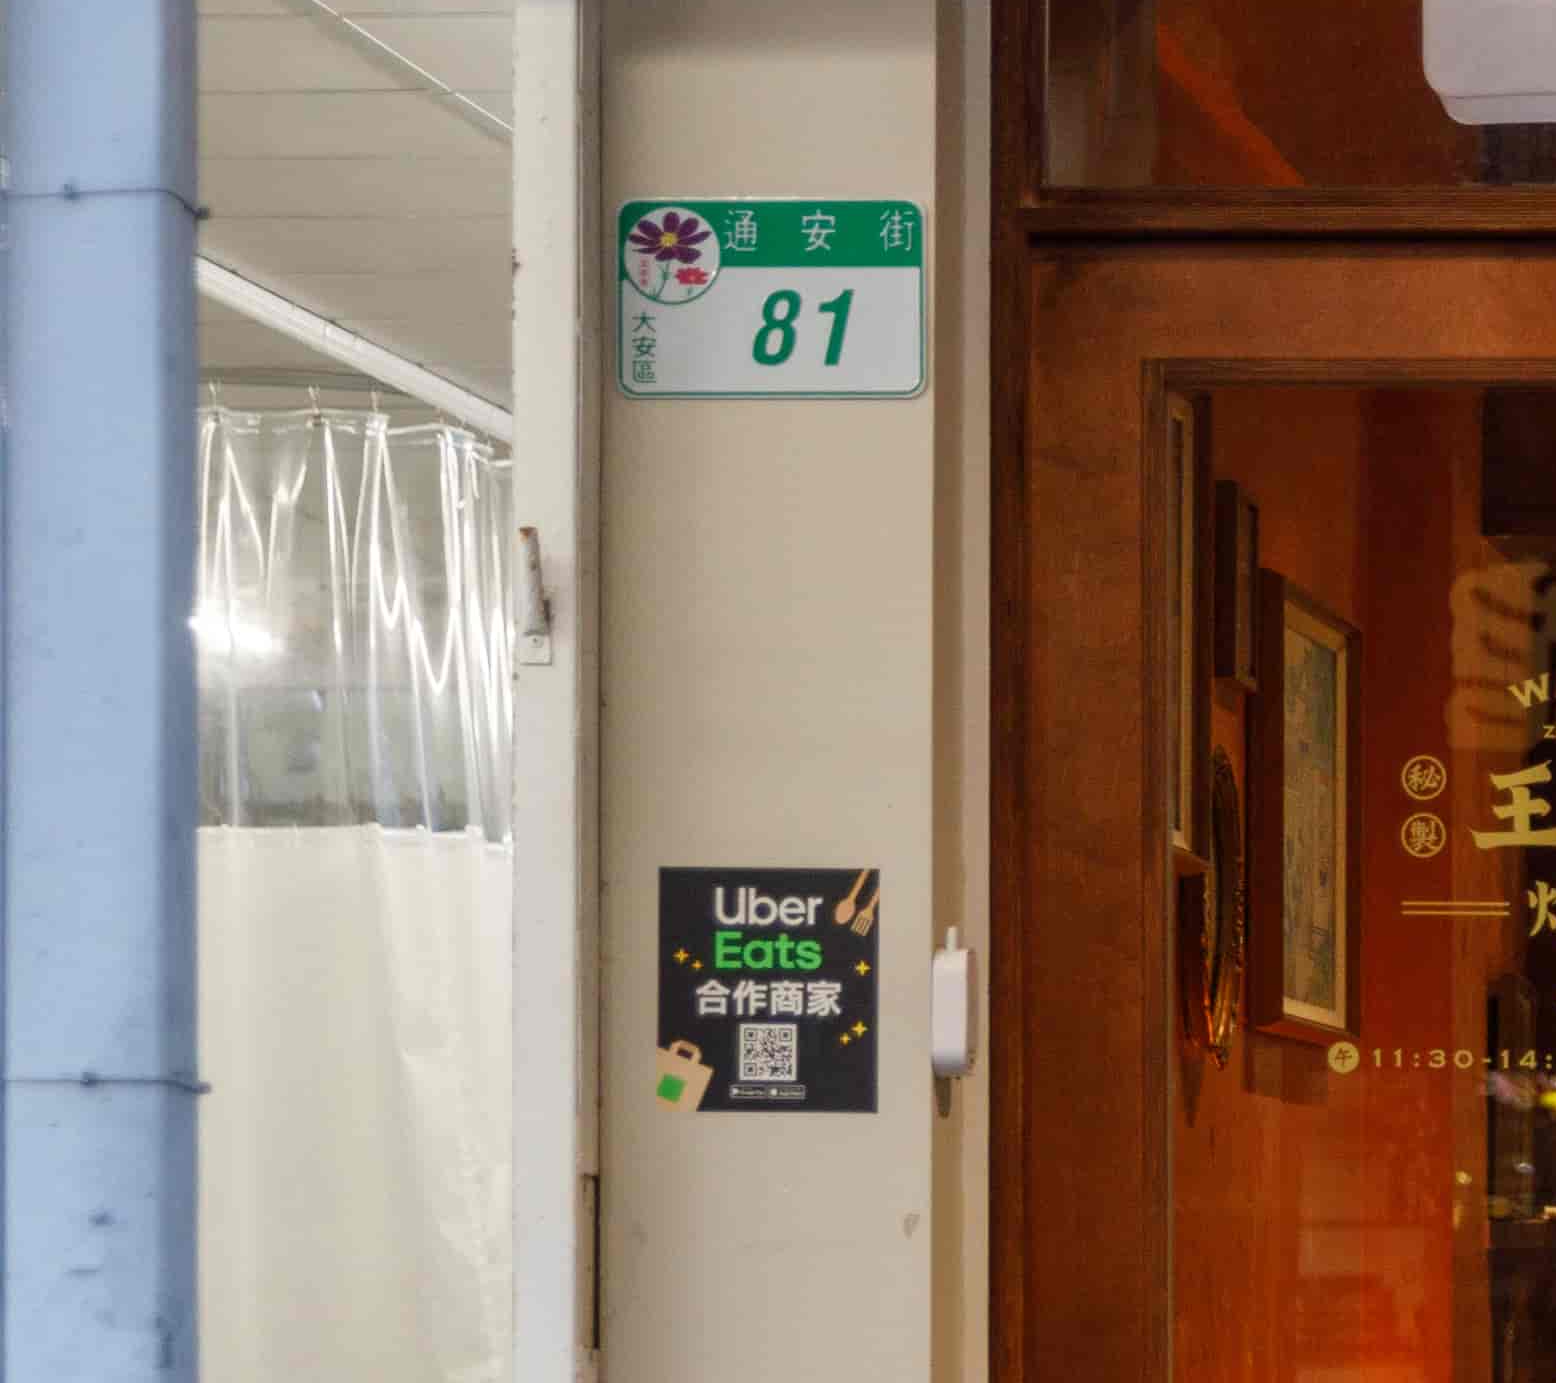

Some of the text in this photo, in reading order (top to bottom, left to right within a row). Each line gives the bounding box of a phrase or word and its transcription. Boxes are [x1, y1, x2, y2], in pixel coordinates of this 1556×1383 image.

[724, 210, 913, 253] 通安街
[632, 312, 656, 384] 大安區
[752, 289, 855, 366] 81
[714, 886, 823, 926] Uber
[714, 931, 823, 971] Eats
[695, 979, 842, 1017] 合作商家
